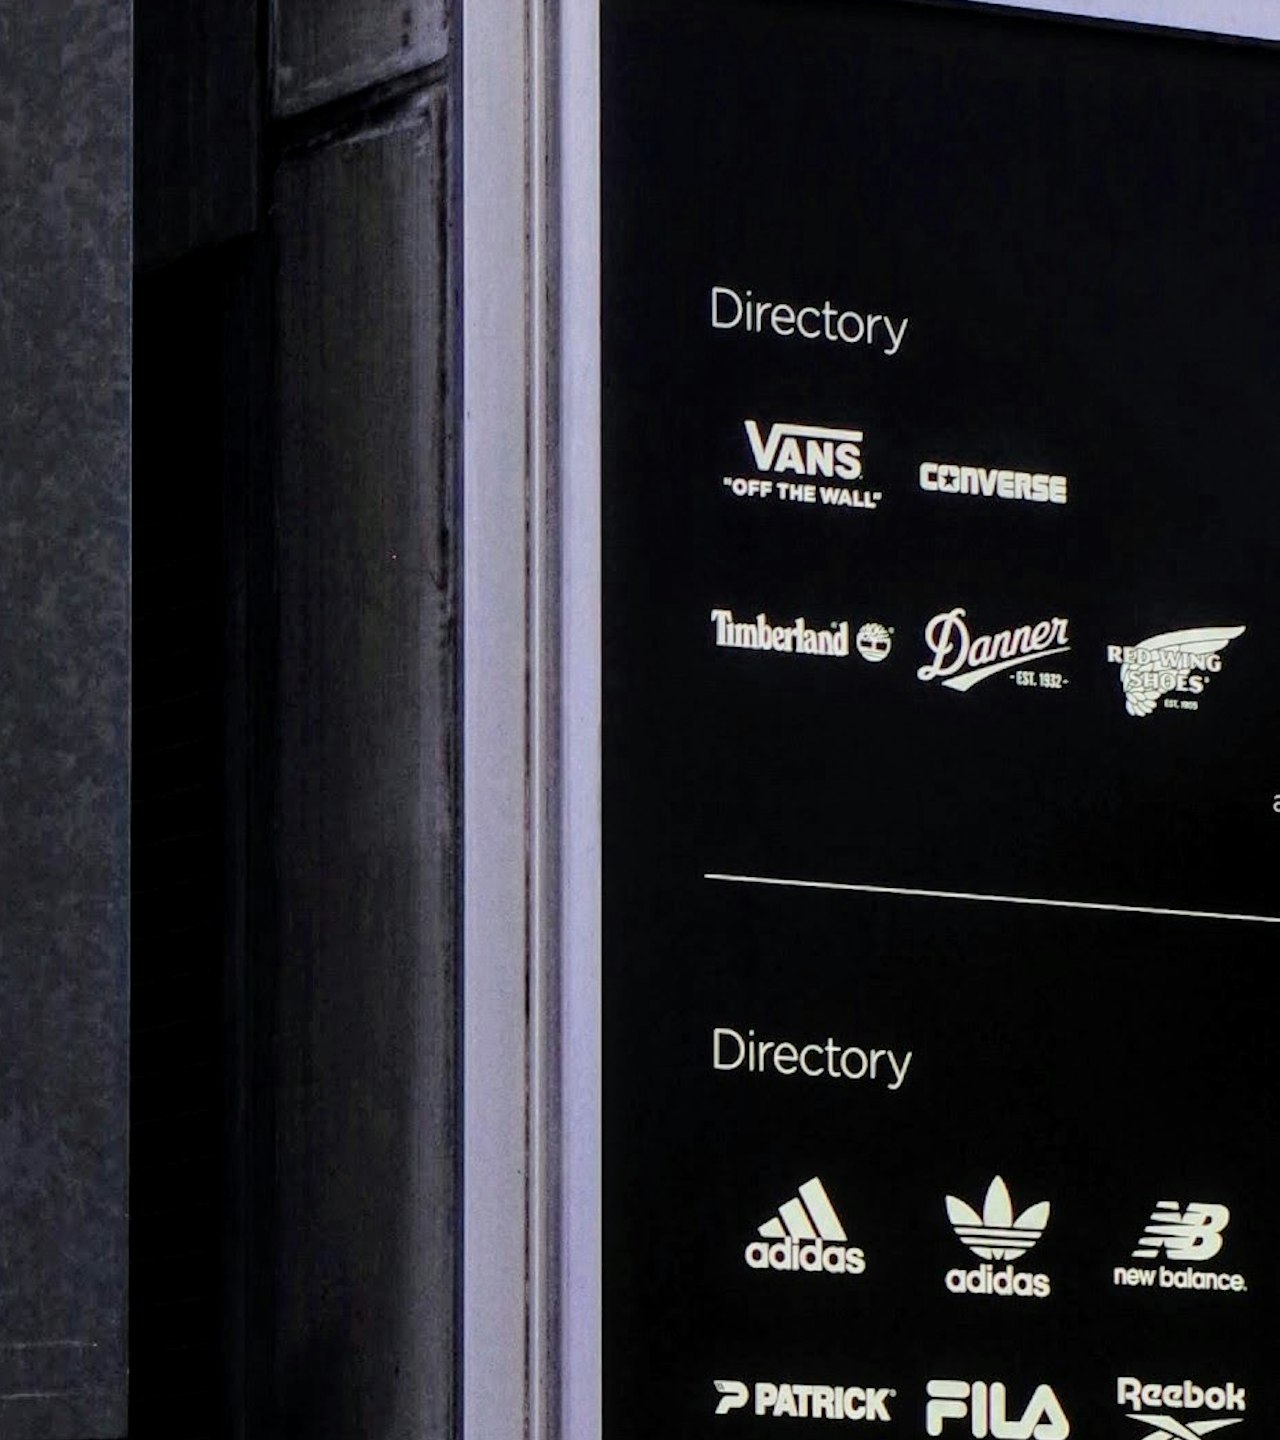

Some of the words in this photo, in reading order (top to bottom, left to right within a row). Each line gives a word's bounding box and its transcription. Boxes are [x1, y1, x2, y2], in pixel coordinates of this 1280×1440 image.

[711, 285, 909, 355] Directory
[745, 419, 863, 480] VANS
[724, 477, 772, 499] "OFF
[777, 482, 815, 503] THE
[820, 487, 882, 508] WALL"
[919, 461, 1067, 505] CONVERSE
[711, 609, 849, 657] Timberland
[917, 606, 1070, 682] Danner
[1106, 645, 1152, 664] RED
[1159, 651, 1222, 672] WING
[1129, 671, 1205, 694] SHOES
[713, 1027, 913, 1090] Directory
[745, 1238, 867, 1274] adidas
[945, 1265, 1050, 1299] adidas
[1114, 1266, 1156, 1287] new
[755, 1383, 892, 1422] PATRICK
[1117, 1377, 1247, 1412] Reebok
